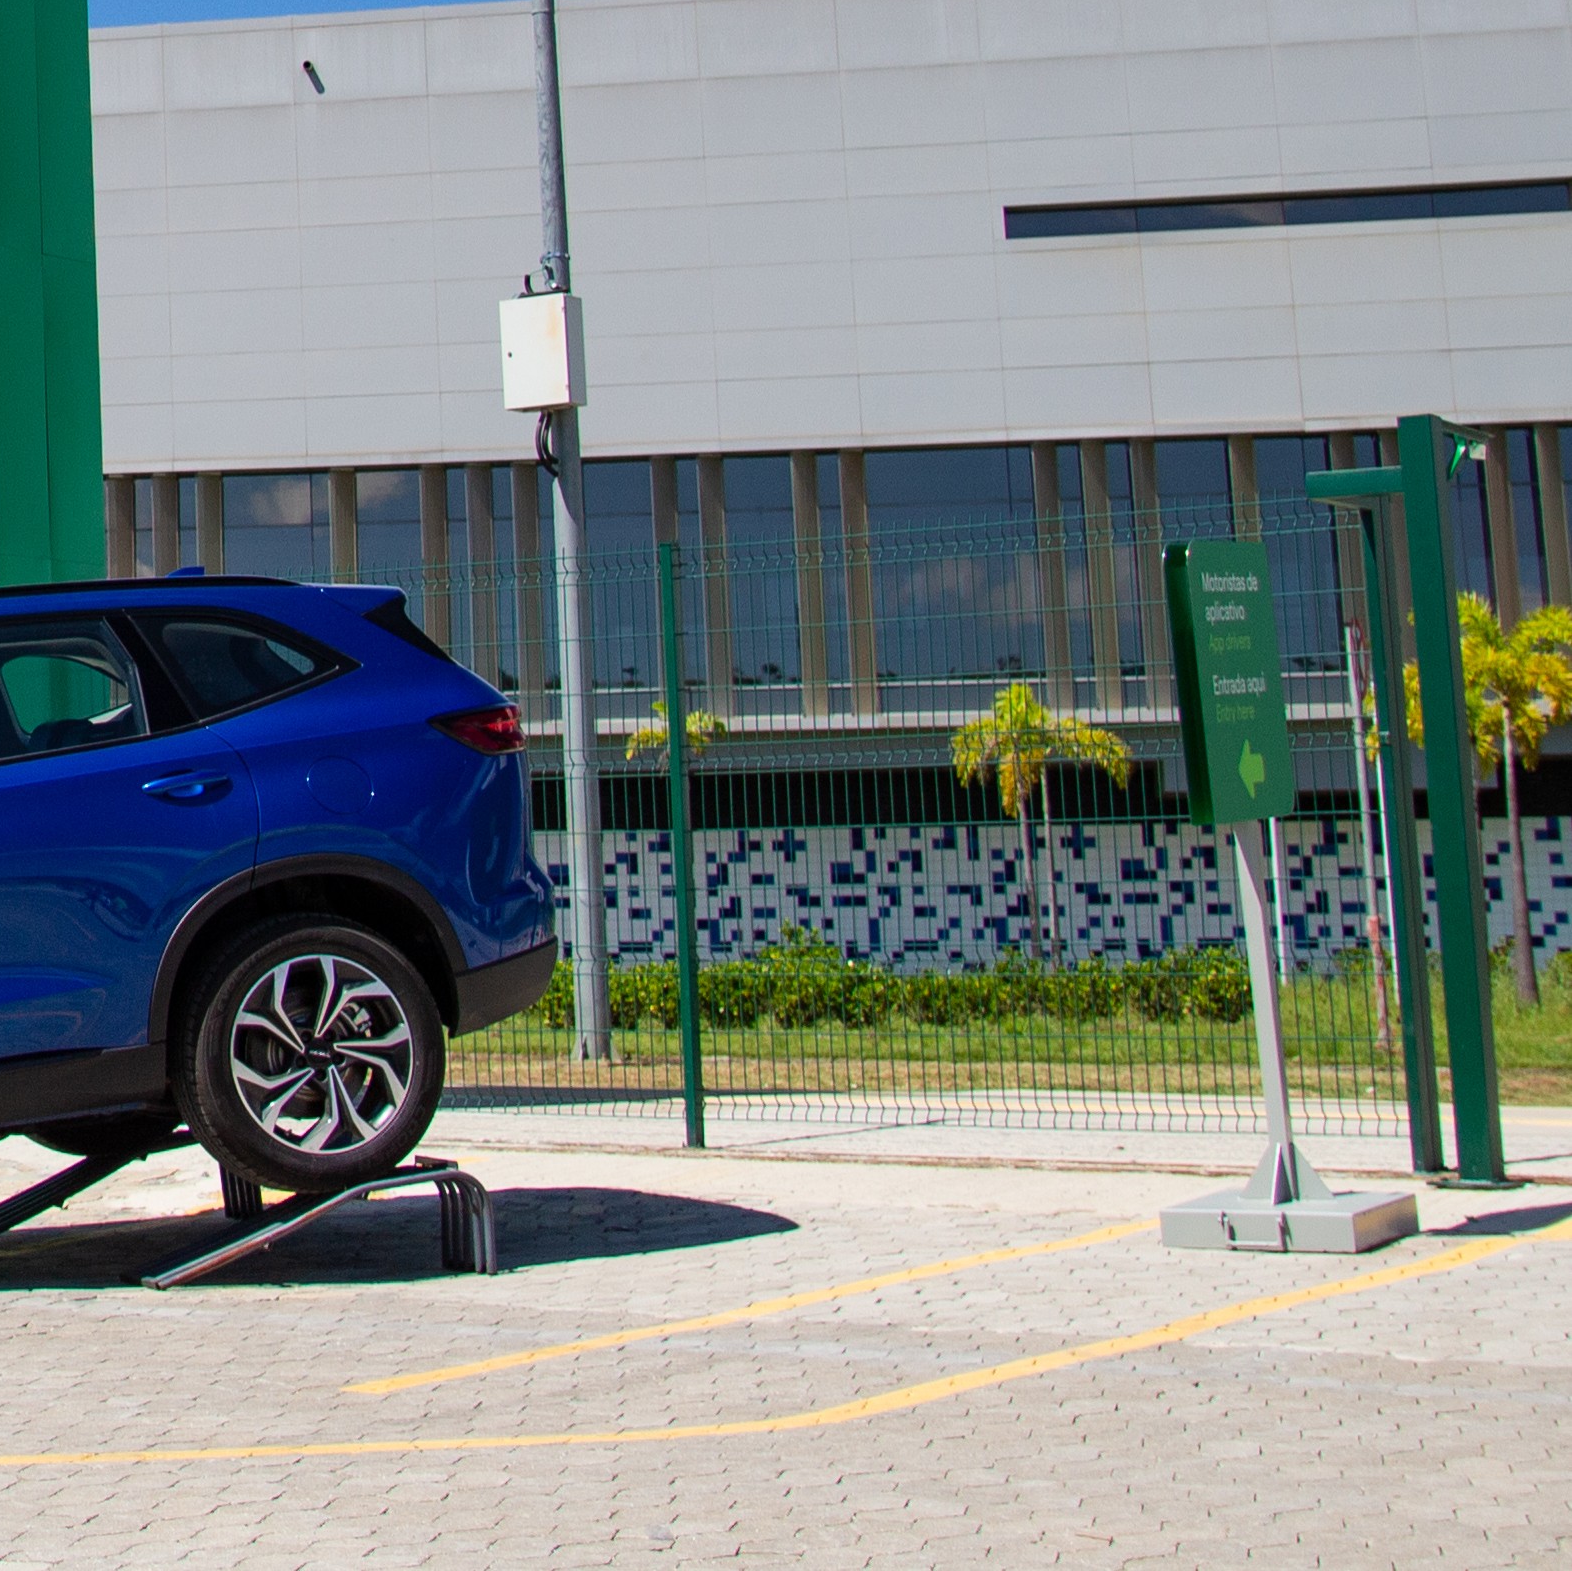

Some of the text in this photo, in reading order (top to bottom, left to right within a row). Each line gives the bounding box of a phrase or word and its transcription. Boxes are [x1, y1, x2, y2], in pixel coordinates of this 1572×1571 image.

[1201, 571, 1259, 593] Motoristas de
[1205, 599, 1246, 626] aplicativo
[1208, 633, 1225, 655] App
[1212, 671, 1266, 699] Entrada aqui
